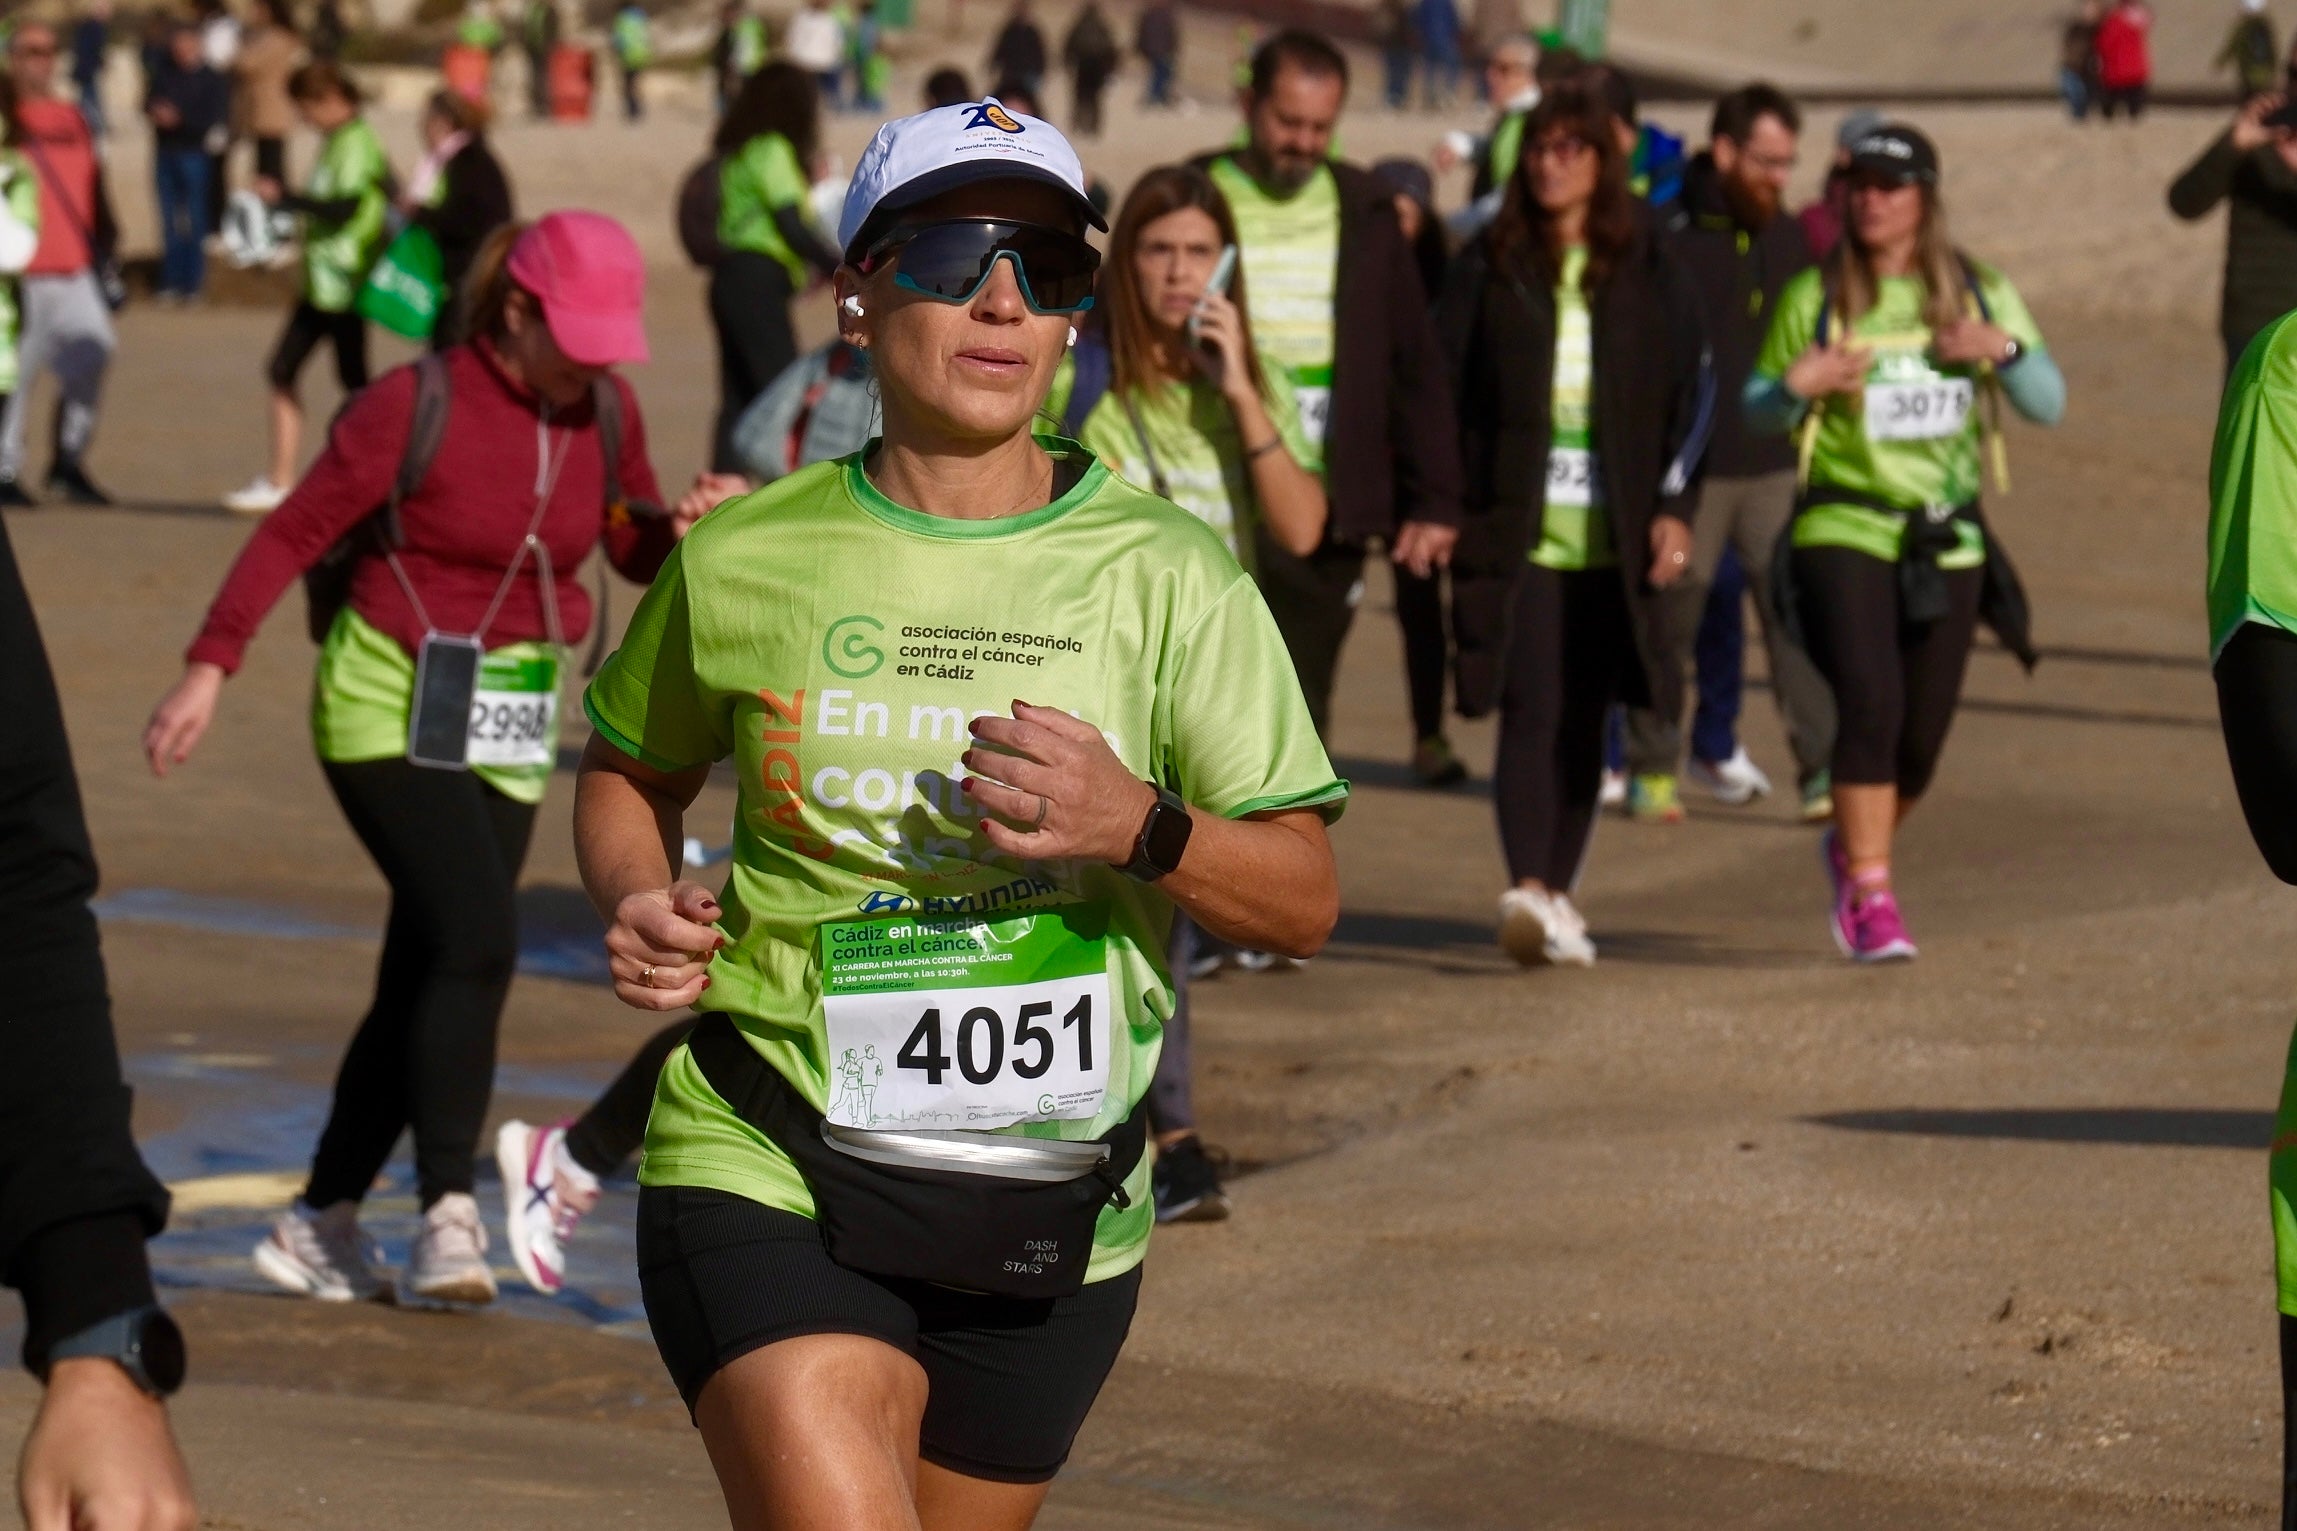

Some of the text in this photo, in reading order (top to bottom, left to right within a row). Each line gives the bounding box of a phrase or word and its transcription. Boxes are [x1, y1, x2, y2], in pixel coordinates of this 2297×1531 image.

[955, 143, 987, 152] Autoridad
[988, 142, 1017, 150] Portuaria
[901, 625, 1083, 653] asociación española
[900, 644, 1045, 667] contra el cáncer
[896, 663, 975, 680] en Cádiz
[817, 689, 889, 738] En
[759, 688, 836, 860] CÁDIZ
[812, 761, 990, 816] cont
[832, 917, 987, 944] Cádiz en marcha
[832, 944, 894, 960] contra
[898, 938, 916, 955] el
[832, 952, 1013, 972] XI CARRERA EN MARCHA CONTRA EL CÁNCER
[832, 975, 844, 984] 23
[845, 974, 858, 983] de
[859, 970, 912, 982] noviembre,
[921, 969, 936, 978] las
[937, 967, 970, 977] 10:30h.
[897, 994, 1093, 1085] 4051
[1024, 1240, 1058, 1251] DASH
[1003, 1260, 1043, 1274] STARS
[1033, 1252, 1059, 1263] AND
